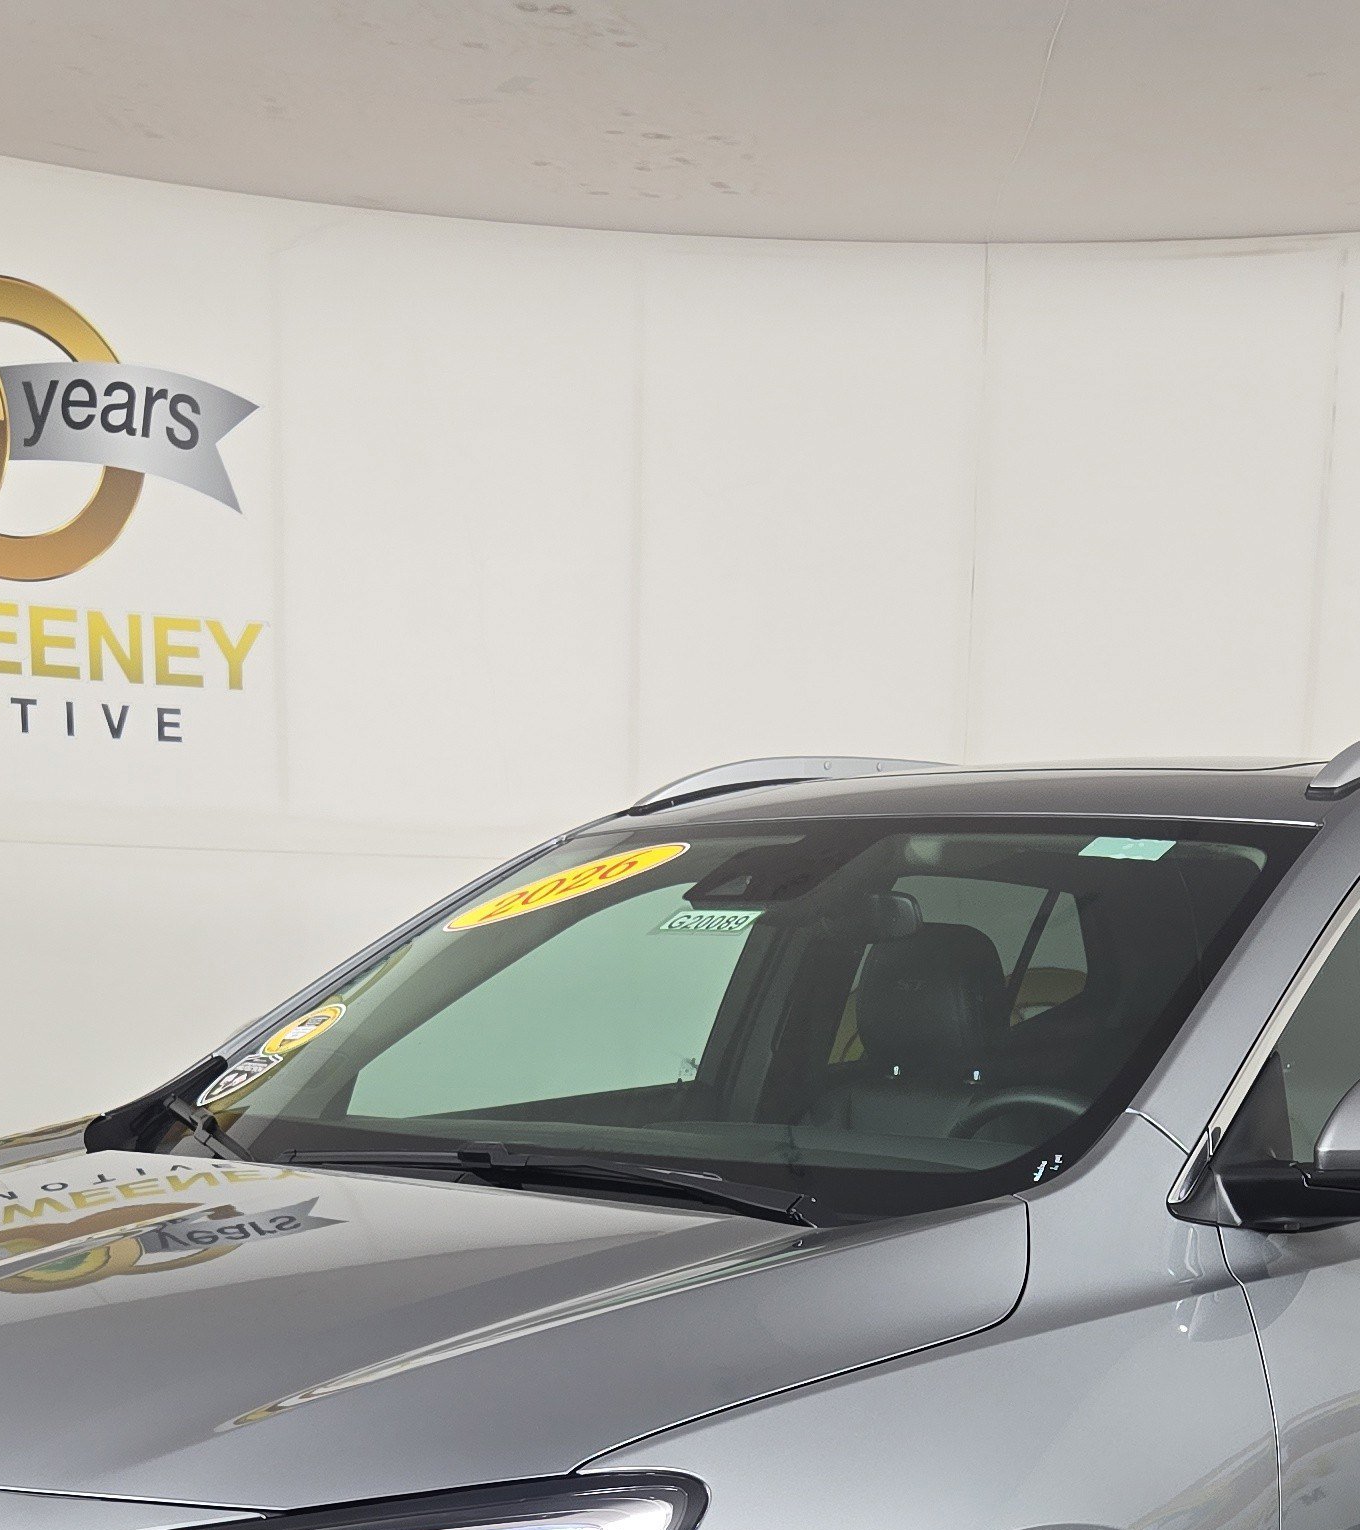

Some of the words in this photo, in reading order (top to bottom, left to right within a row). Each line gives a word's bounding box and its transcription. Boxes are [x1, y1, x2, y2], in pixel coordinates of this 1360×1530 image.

[22, 378, 201, 450] years
[478, 850, 653, 922] 2026
[668, 915, 750, 930] G20089
